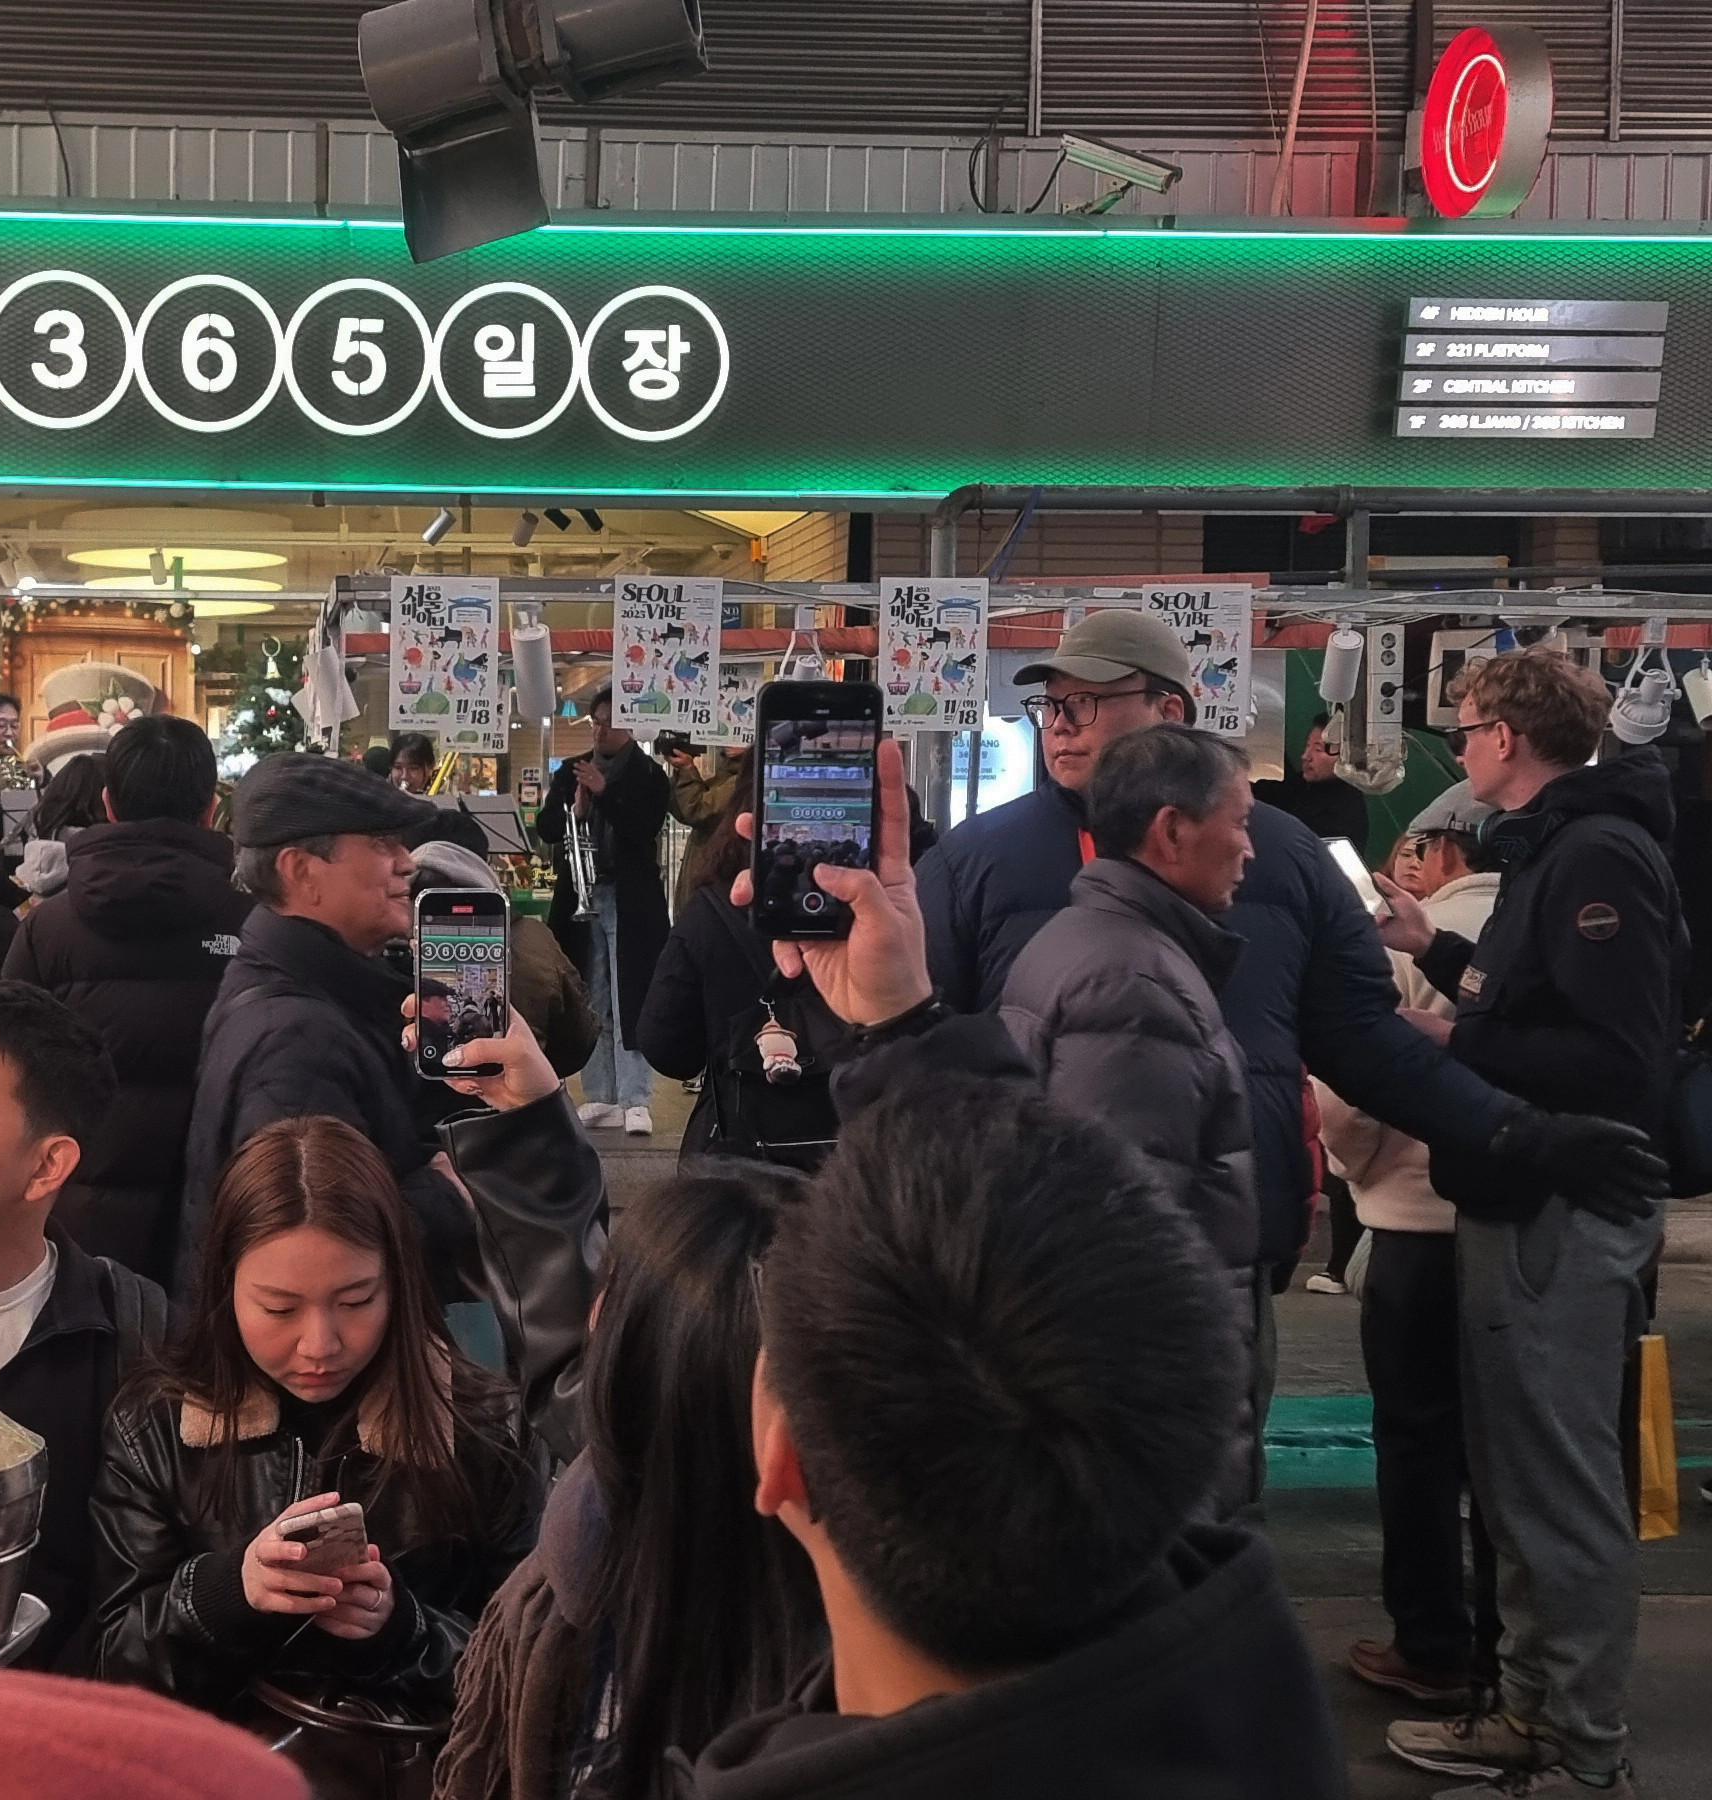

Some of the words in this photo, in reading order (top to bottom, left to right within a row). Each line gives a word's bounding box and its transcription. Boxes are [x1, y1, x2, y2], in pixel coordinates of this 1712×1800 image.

[1449, 306, 1505, 322] HIDDEN
[1506, 307, 1549, 322] HOUR
[30, 309, 691, 401] 365일장
[1474, 343, 1550, 358] PLATFORM
[1443, 379, 1509, 394] CENTRAL
[1511, 379, 1576, 394] KITCHEN
[1561, 416, 1626, 430] KITCHEN
[399, 584, 446, 614] 서울
[621, 583, 691, 604] SEOUL
[888, 586, 936, 615] 서울
[1148, 591, 1219, 612] SEOUL
[401, 602, 446, 631] 바이브
[645, 603, 687, 621] VIBE
[890, 604, 934, 632] 바이브
[1173, 611, 1215, 627] VIBE
[470, 709, 490, 725] 18
[691, 709, 711, 725] 18
[958, 709, 978, 725] 18
[1218, 715, 1239, 730] 18
[201, 940, 230, 949] NORTH
